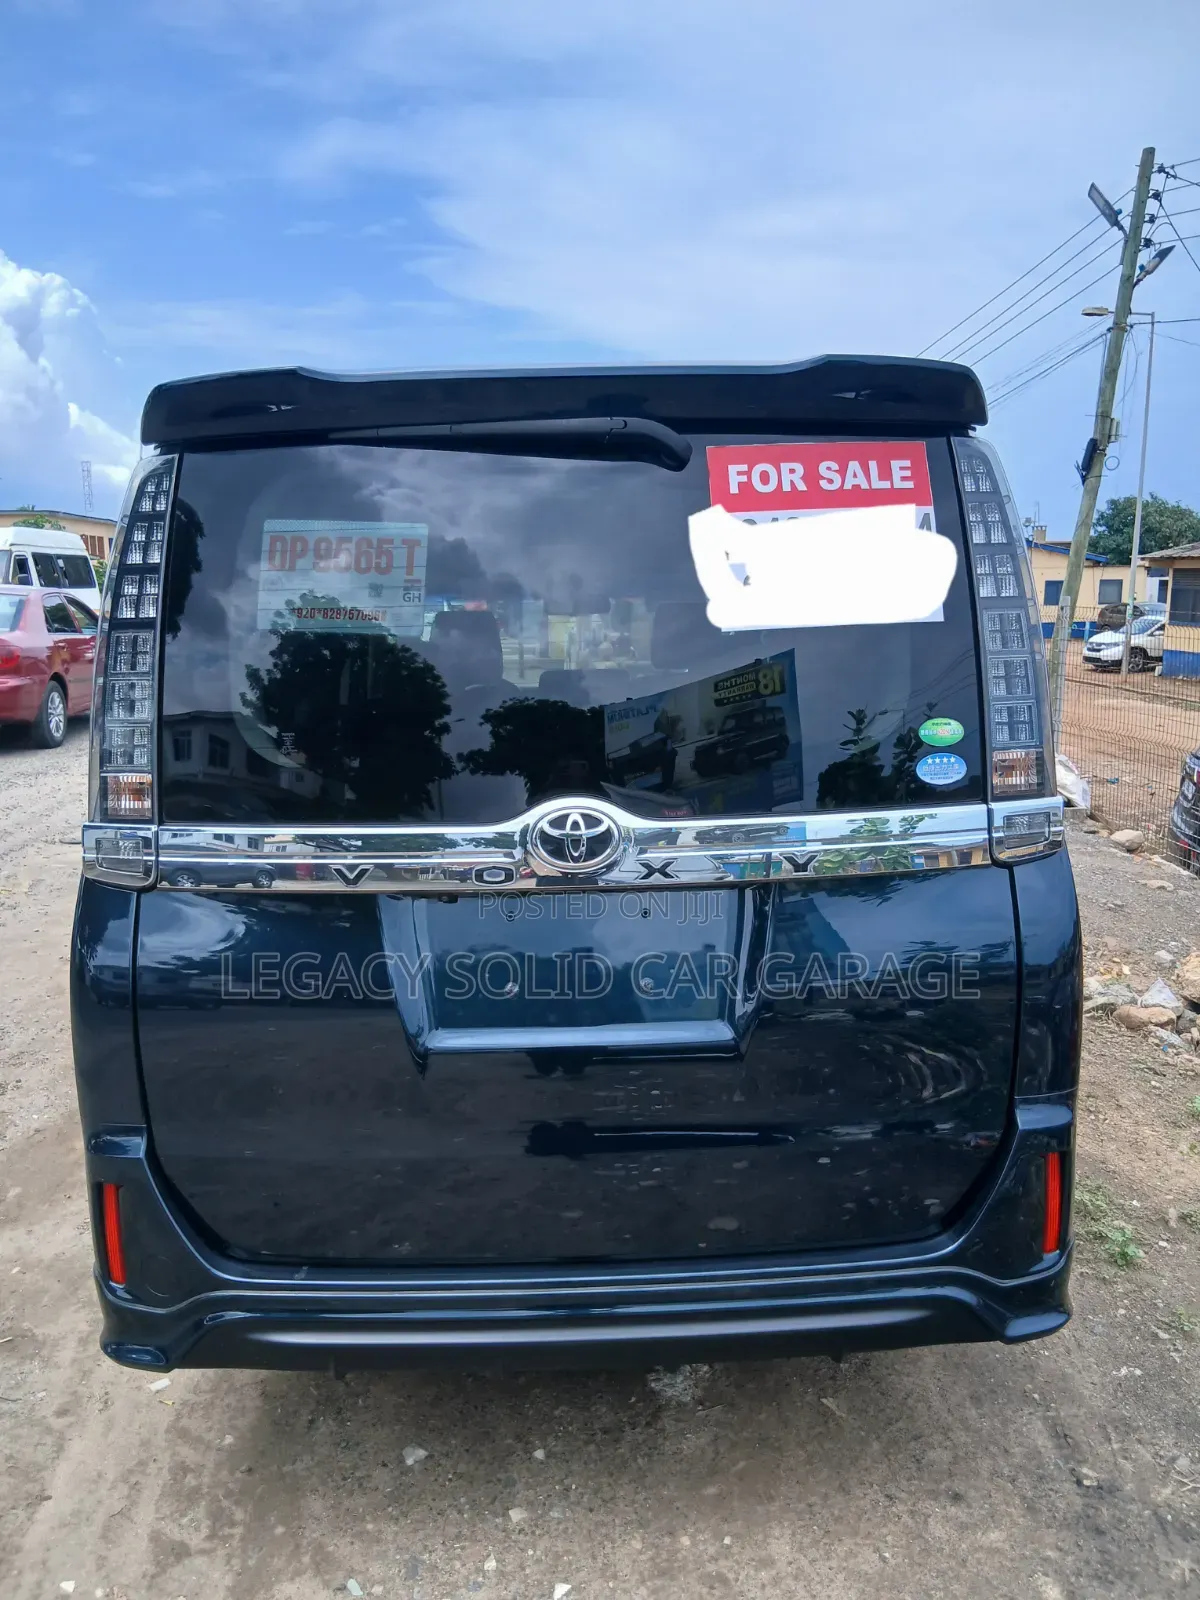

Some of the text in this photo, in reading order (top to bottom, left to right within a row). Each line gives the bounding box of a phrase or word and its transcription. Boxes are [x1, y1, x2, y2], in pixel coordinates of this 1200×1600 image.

[727, 459, 915, 494] FOR SALE
[402, 592, 421, 603] GH
